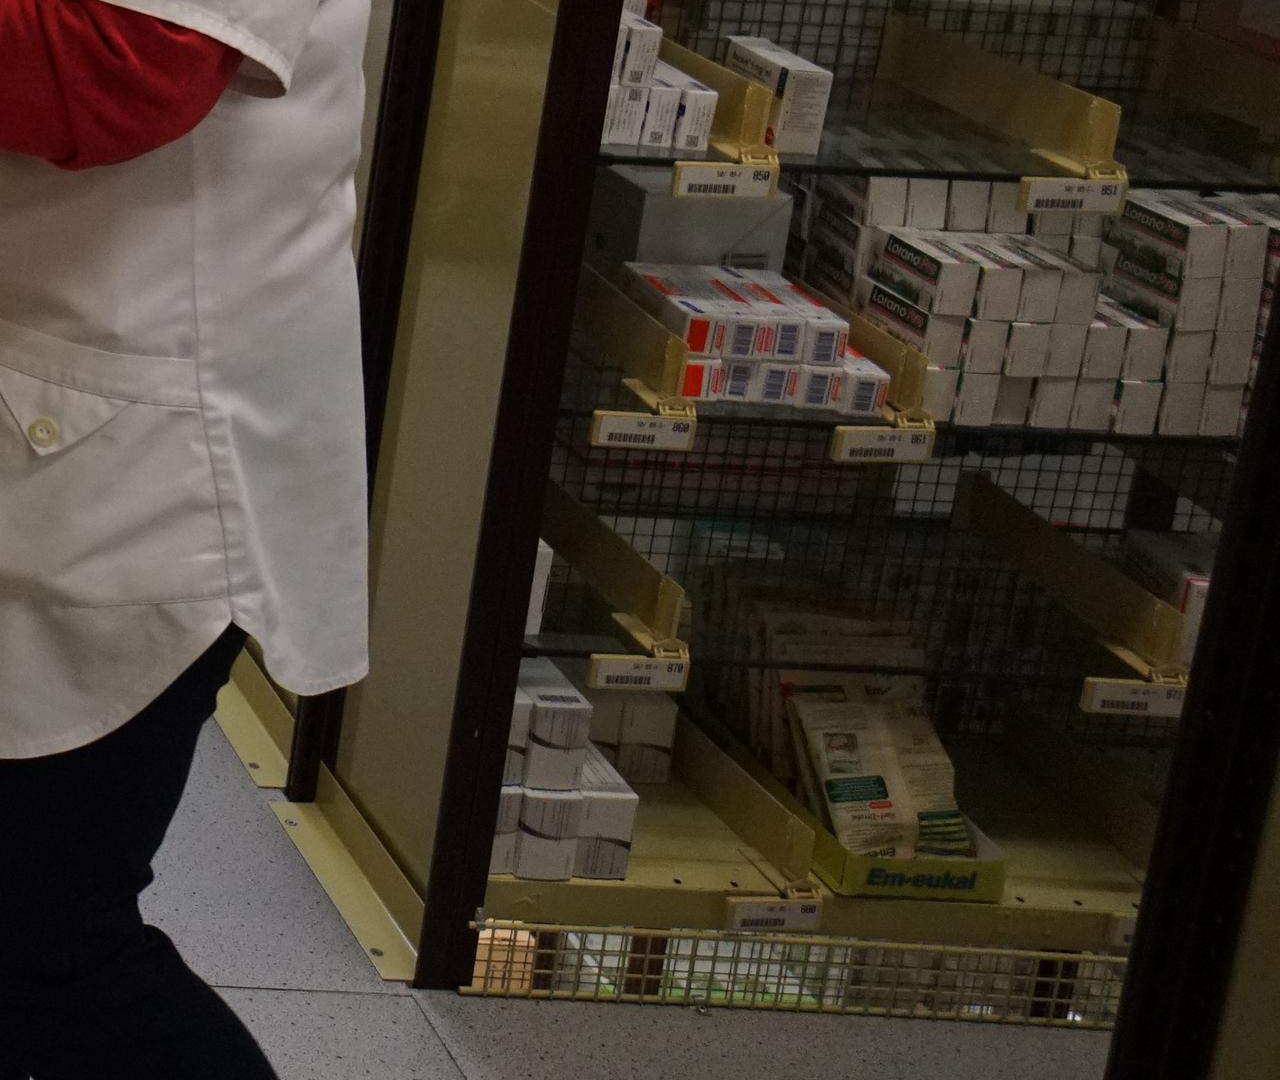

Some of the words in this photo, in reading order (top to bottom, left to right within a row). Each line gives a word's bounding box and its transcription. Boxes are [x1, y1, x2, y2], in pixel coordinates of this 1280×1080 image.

[887, 236, 921, 267] Lorano
[871, 286, 907, 318] Lorano
[867, 867, 977, 890] Em-eukal
